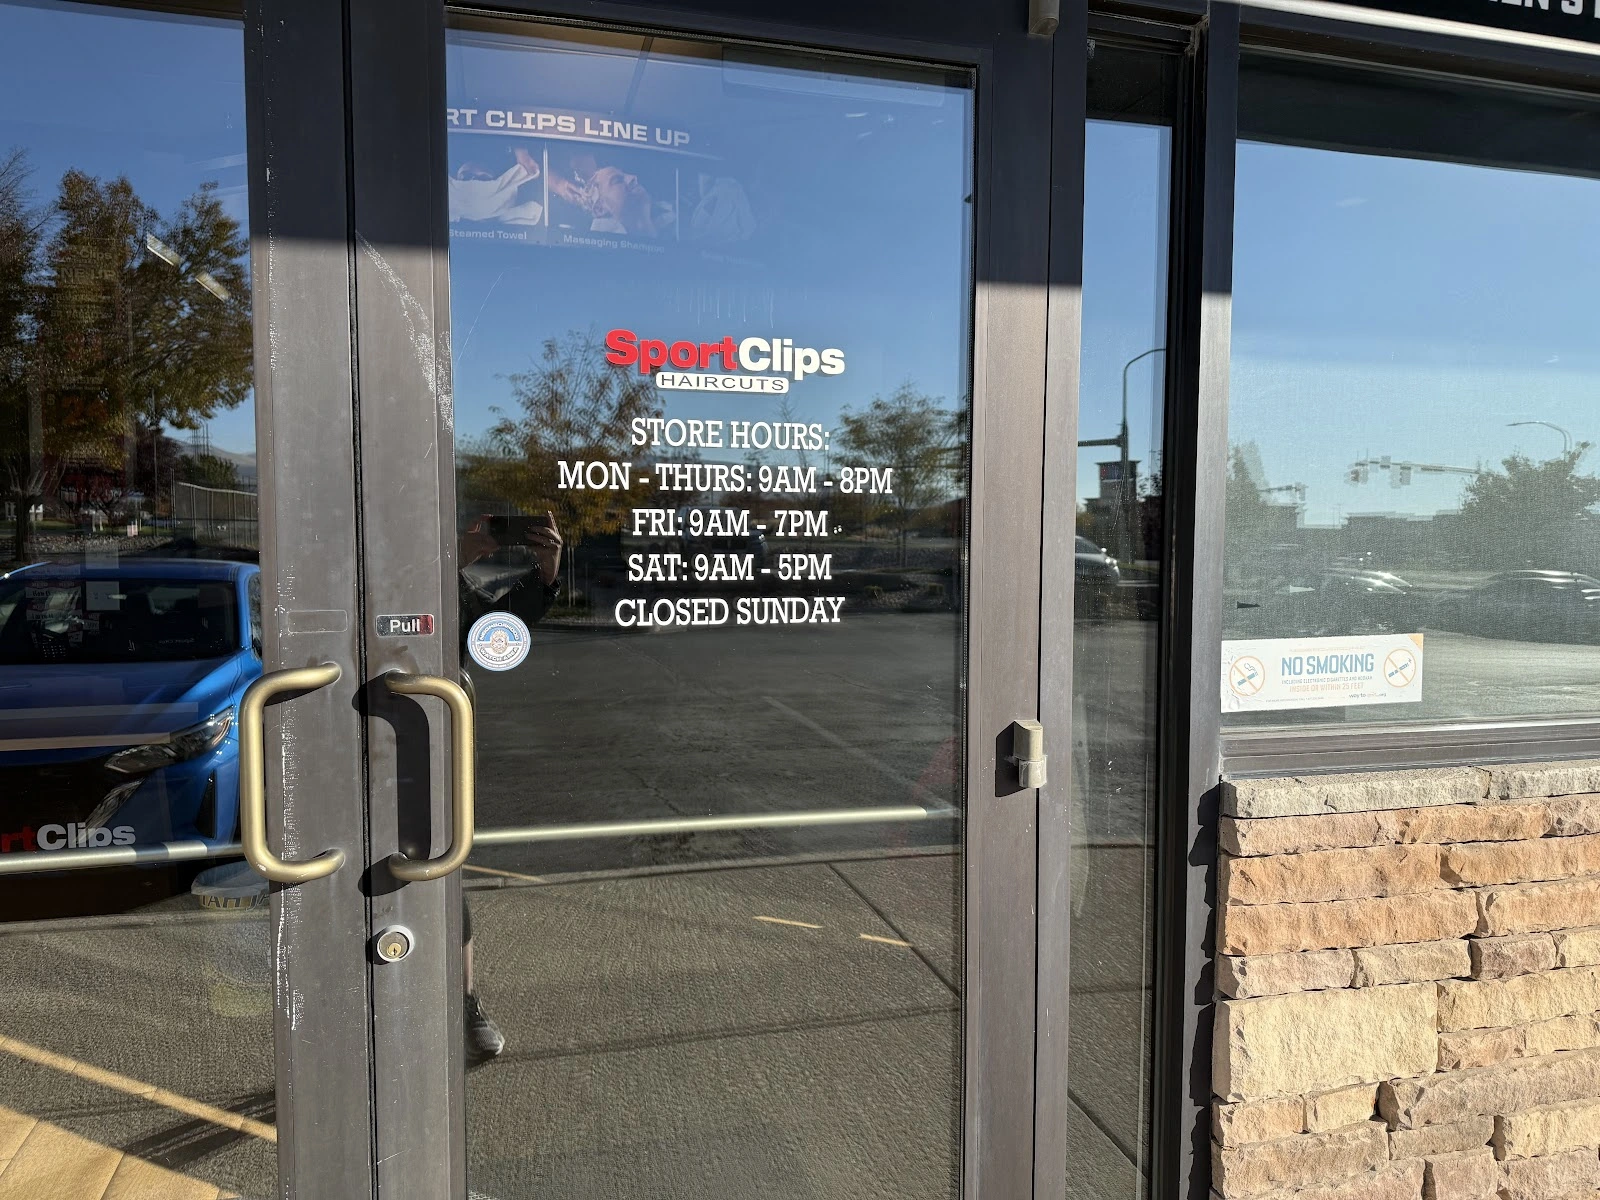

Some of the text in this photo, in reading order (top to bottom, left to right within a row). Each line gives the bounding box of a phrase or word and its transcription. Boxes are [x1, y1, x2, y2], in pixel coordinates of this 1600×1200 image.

[486, 110, 576, 133] CLIPS
[584, 118, 648, 142] LINE
[655, 127, 690, 147] UP
[449, 229, 527, 240] Steamed Towel
[563, 234, 618, 249] Massaging
[661, 374, 784, 391] HAIRCUTS
[631, 417, 830, 450] STORE HOURS:
[558, 461, 632, 490] MON
[656, 463, 751, 492] THURS:
[759, 465, 816, 493] 9AM
[840, 466, 893, 494] 8PM
[632, 508, 683, 536] FRI:
[689, 509, 750, 537] 9AM
[774, 510, 828, 537] 7PM
[628, 553, 688, 582] SAT:
[694, 554, 754, 581] 9AM
[778, 554, 832, 581] 5PM
[614, 597, 845, 627] CLOSED SUNDAY
[390, 618, 420, 633] Pull
[480, 647, 502, 662] WATCH
[1281, 653, 1375, 676] NO SMOKING
[1289, 684, 1310, 692] INSIDE
[1320, 683, 1341, 691] WITHIN
[1342, 682, 1350, 690] 25
[1350, 682, 1364, 690] FEET
